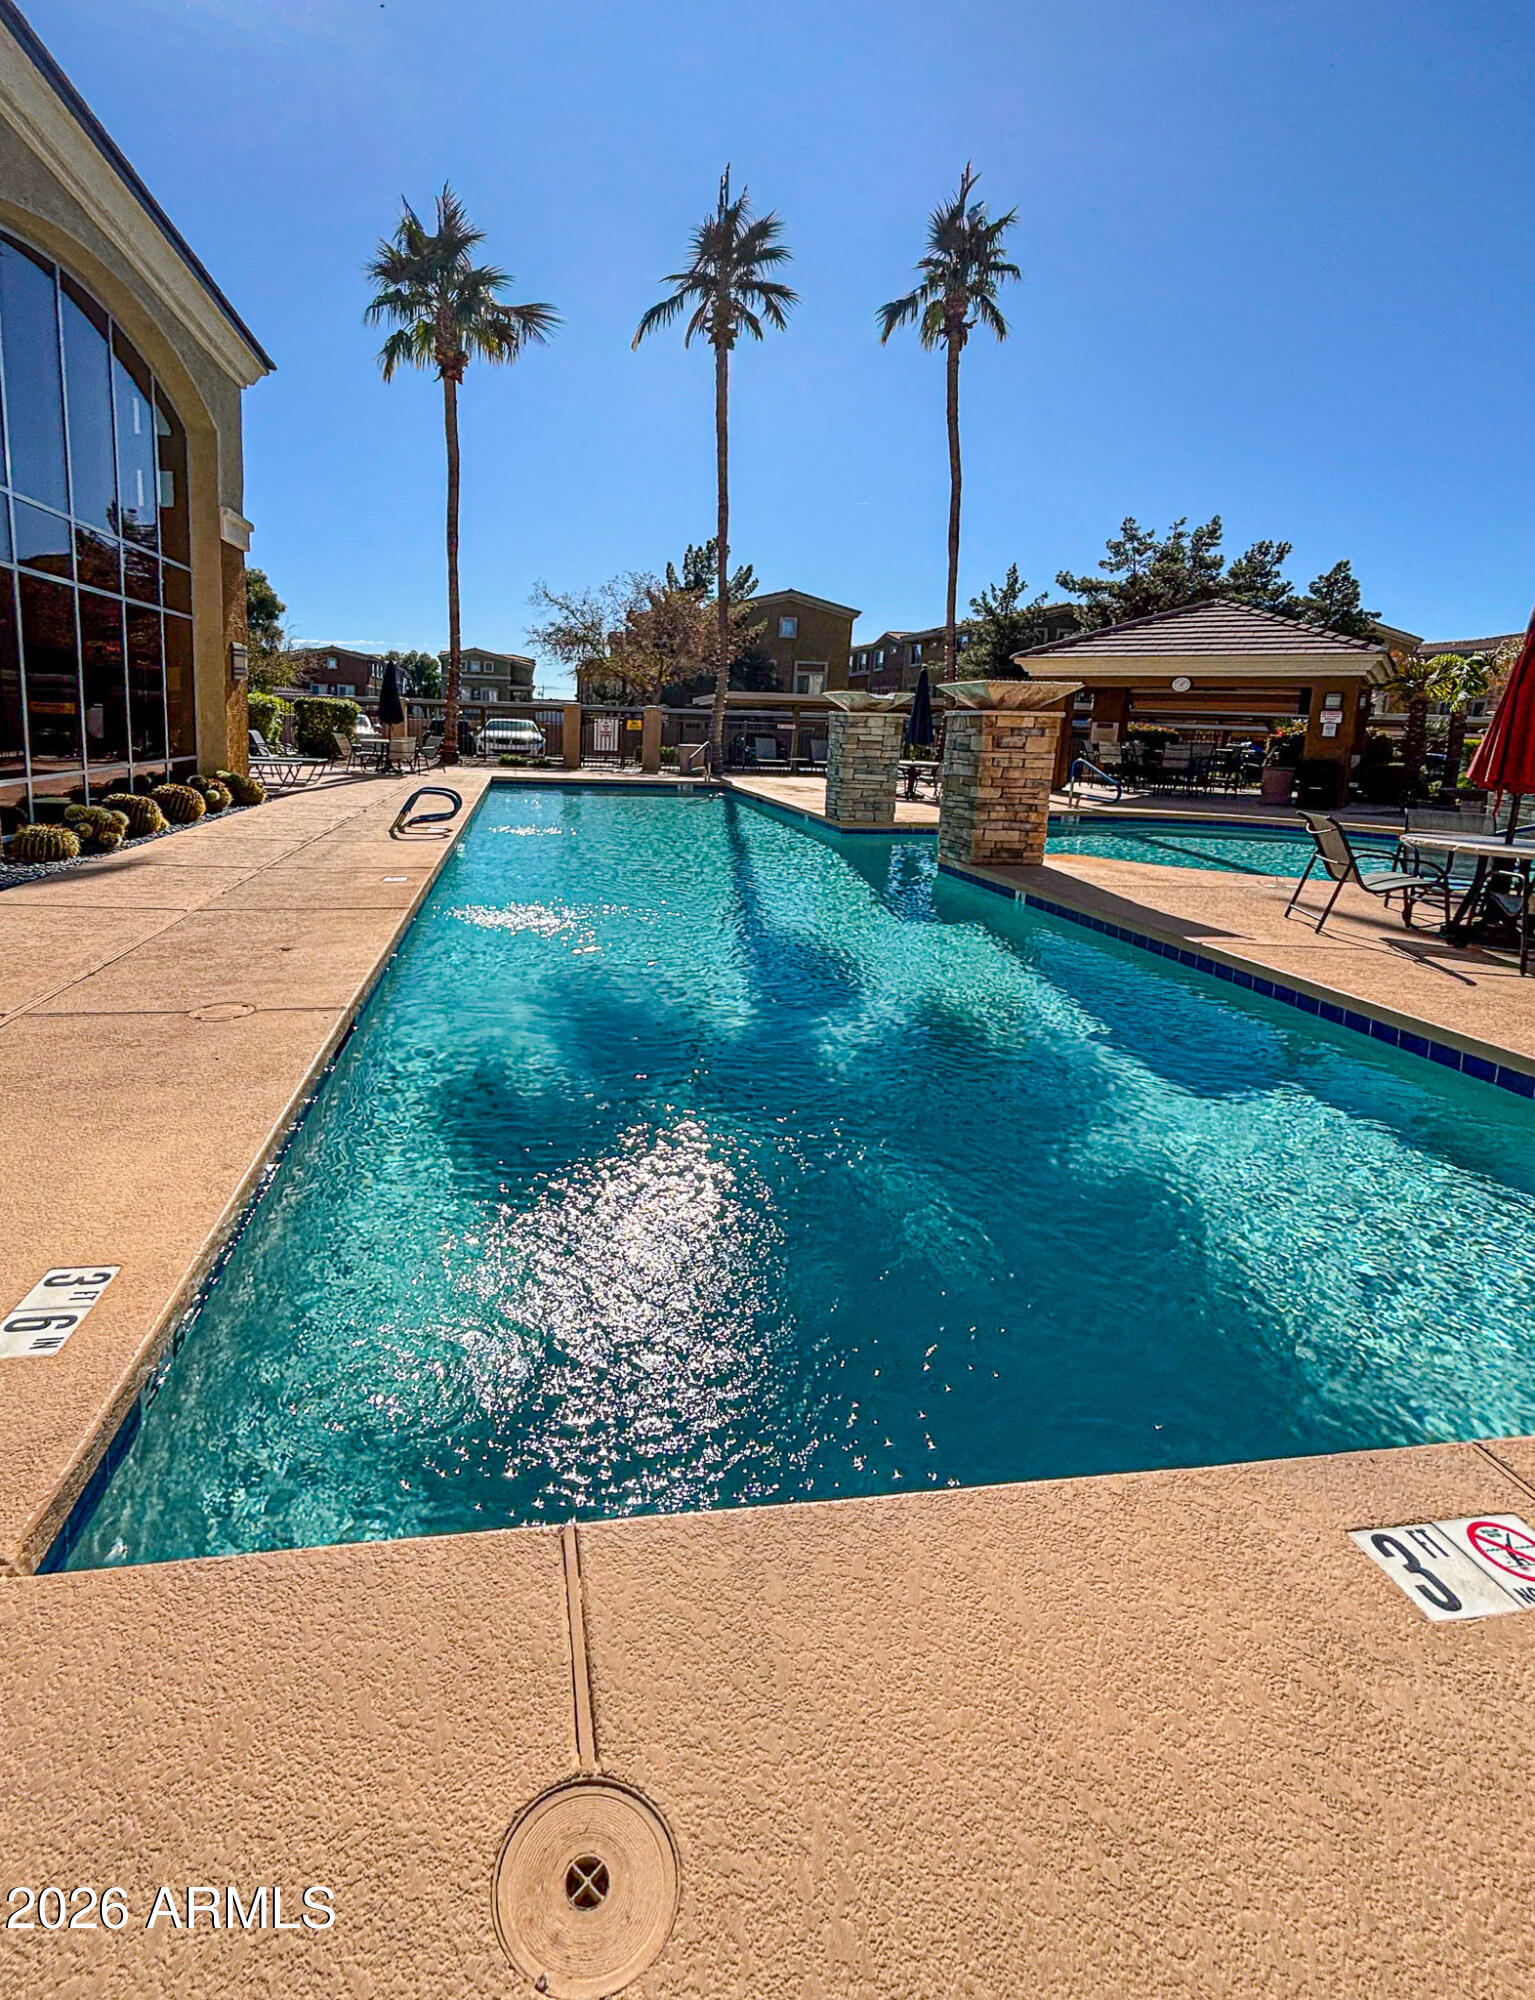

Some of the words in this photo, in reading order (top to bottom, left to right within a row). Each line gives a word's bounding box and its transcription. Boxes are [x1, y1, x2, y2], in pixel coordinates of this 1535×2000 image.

[43, 1272, 112, 1287] 3
[68, 1290, 100, 1301] FT
[3, 1314, 78, 1332] 6
[28, 1336, 65, 1350] IN
[1405, 1528, 1450, 1559] FT
[1371, 1533, 1462, 1612] 3
